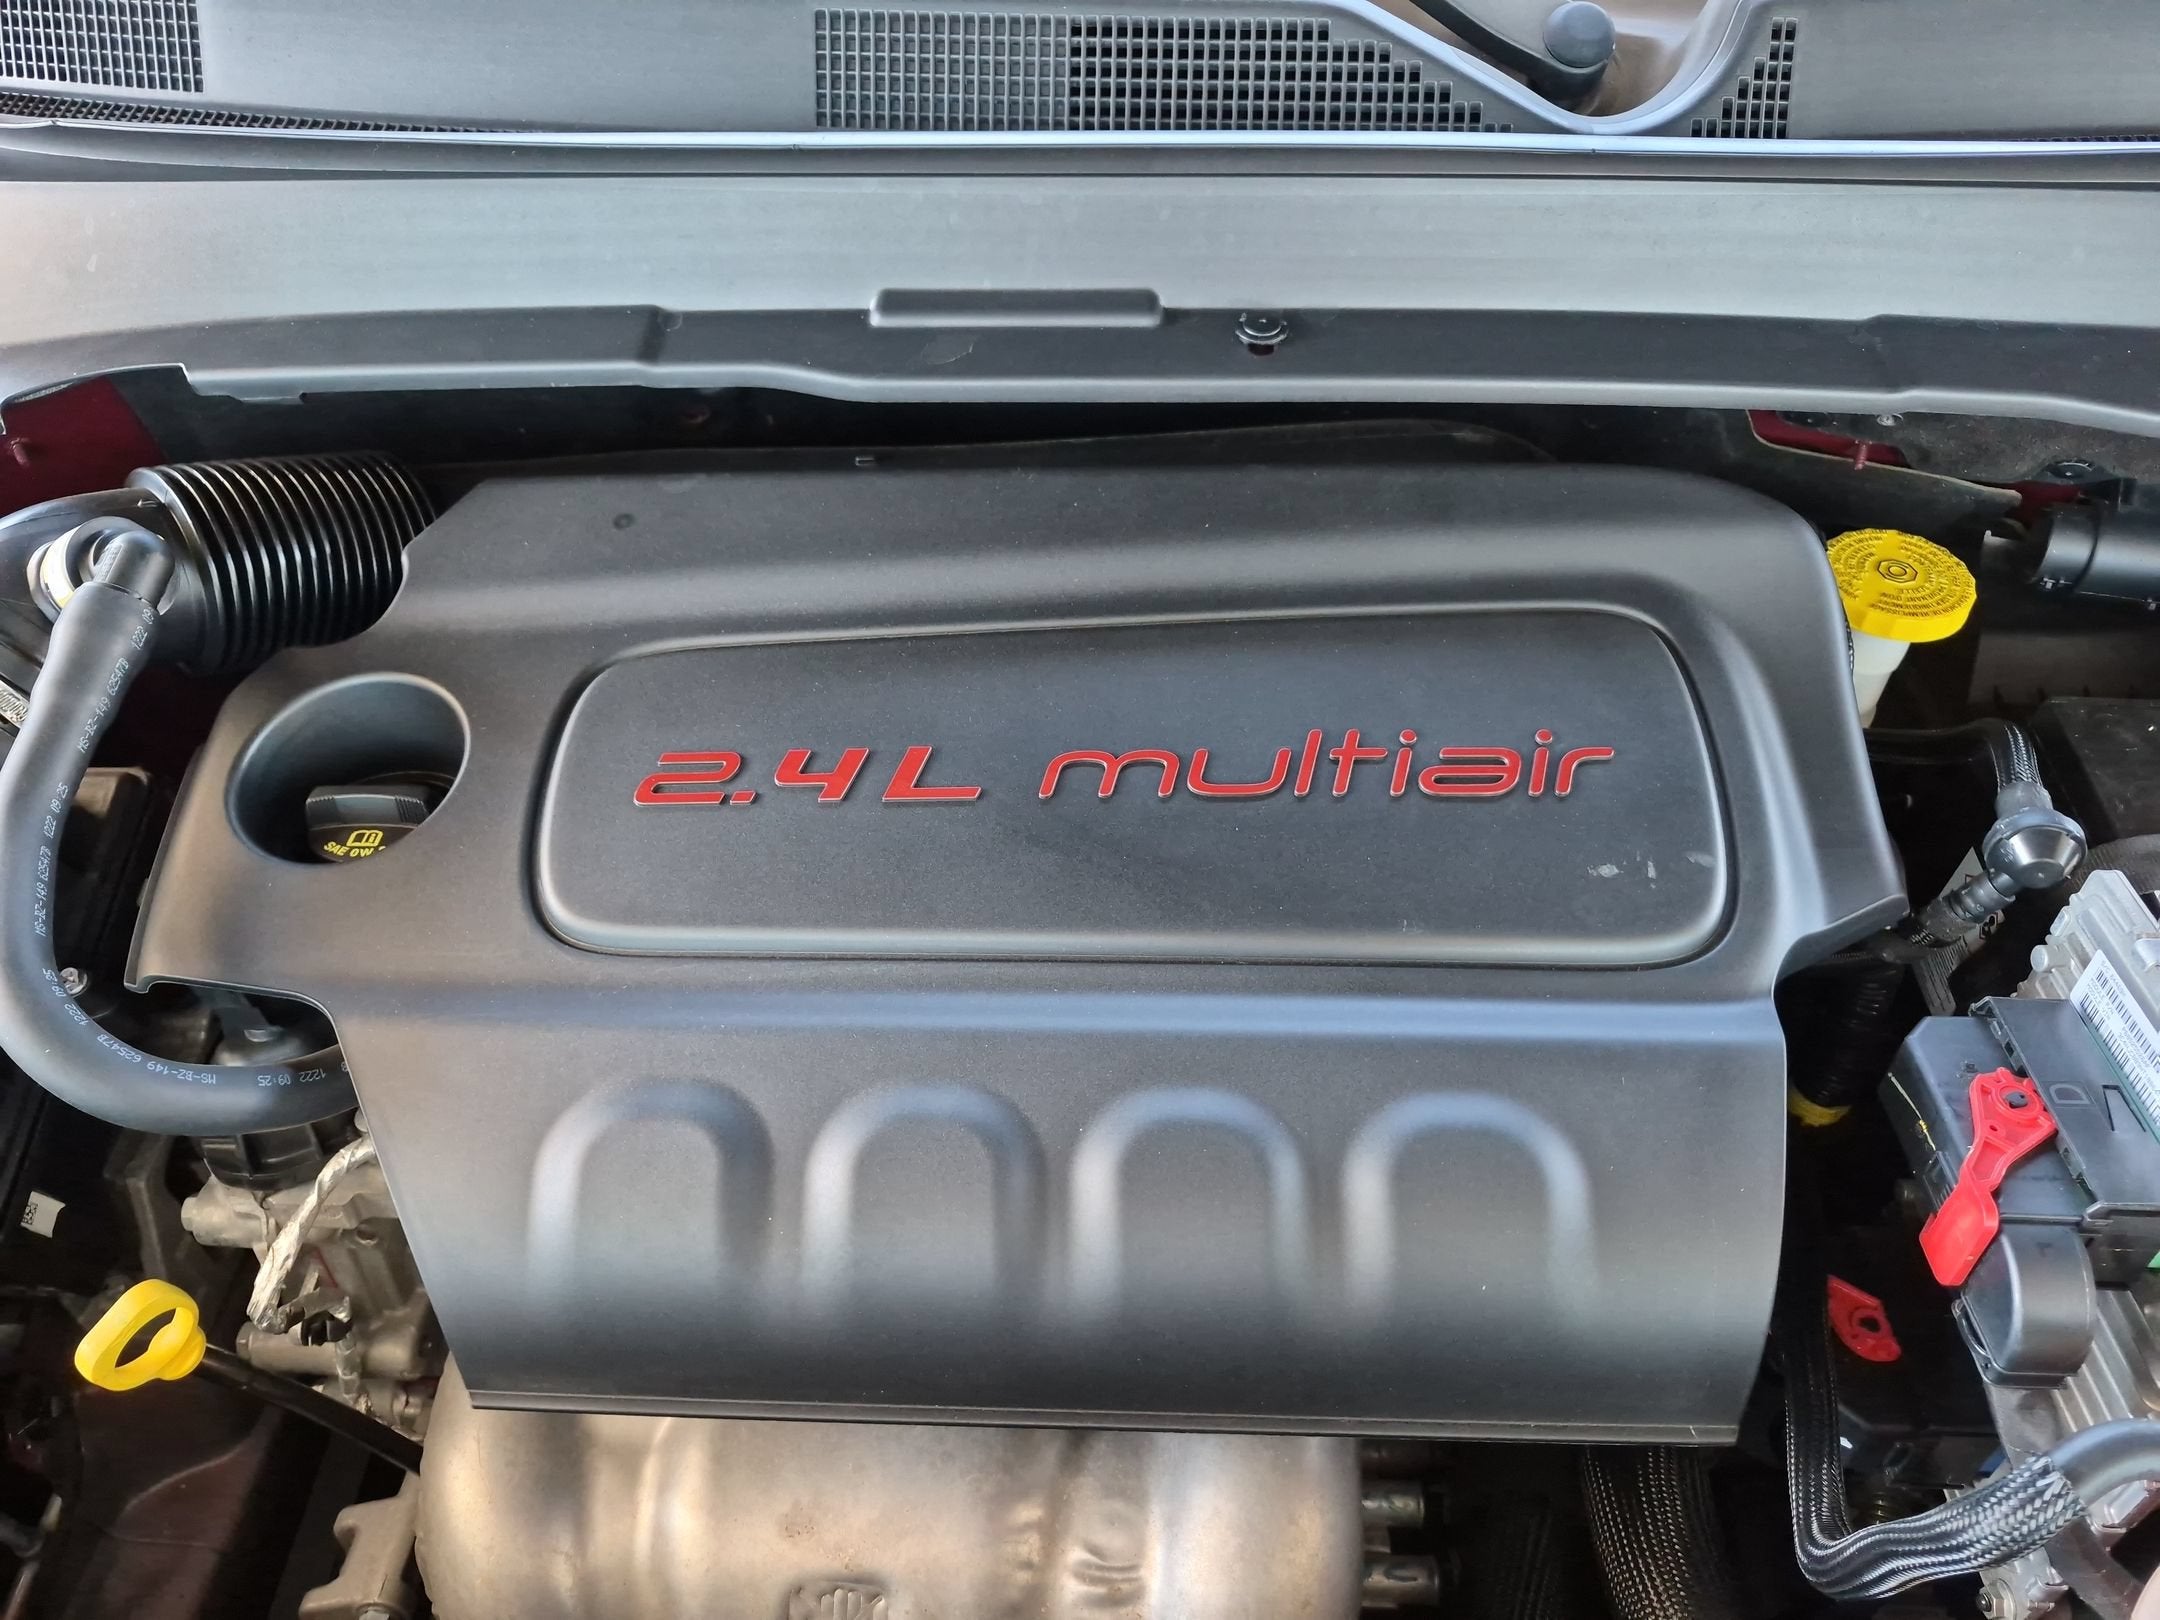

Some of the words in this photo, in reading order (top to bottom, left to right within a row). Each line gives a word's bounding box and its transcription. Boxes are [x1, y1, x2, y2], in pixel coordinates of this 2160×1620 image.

[1037, 728, 1615, 799] multiair
[323, 841, 350, 857] SAE
[64, 1003, 90, 1026] 1222
[96, 1033, 142, 1064] 62547B
[257, 1074, 292, 1087] 09:25
[298, 1067, 327, 1083] 1222
